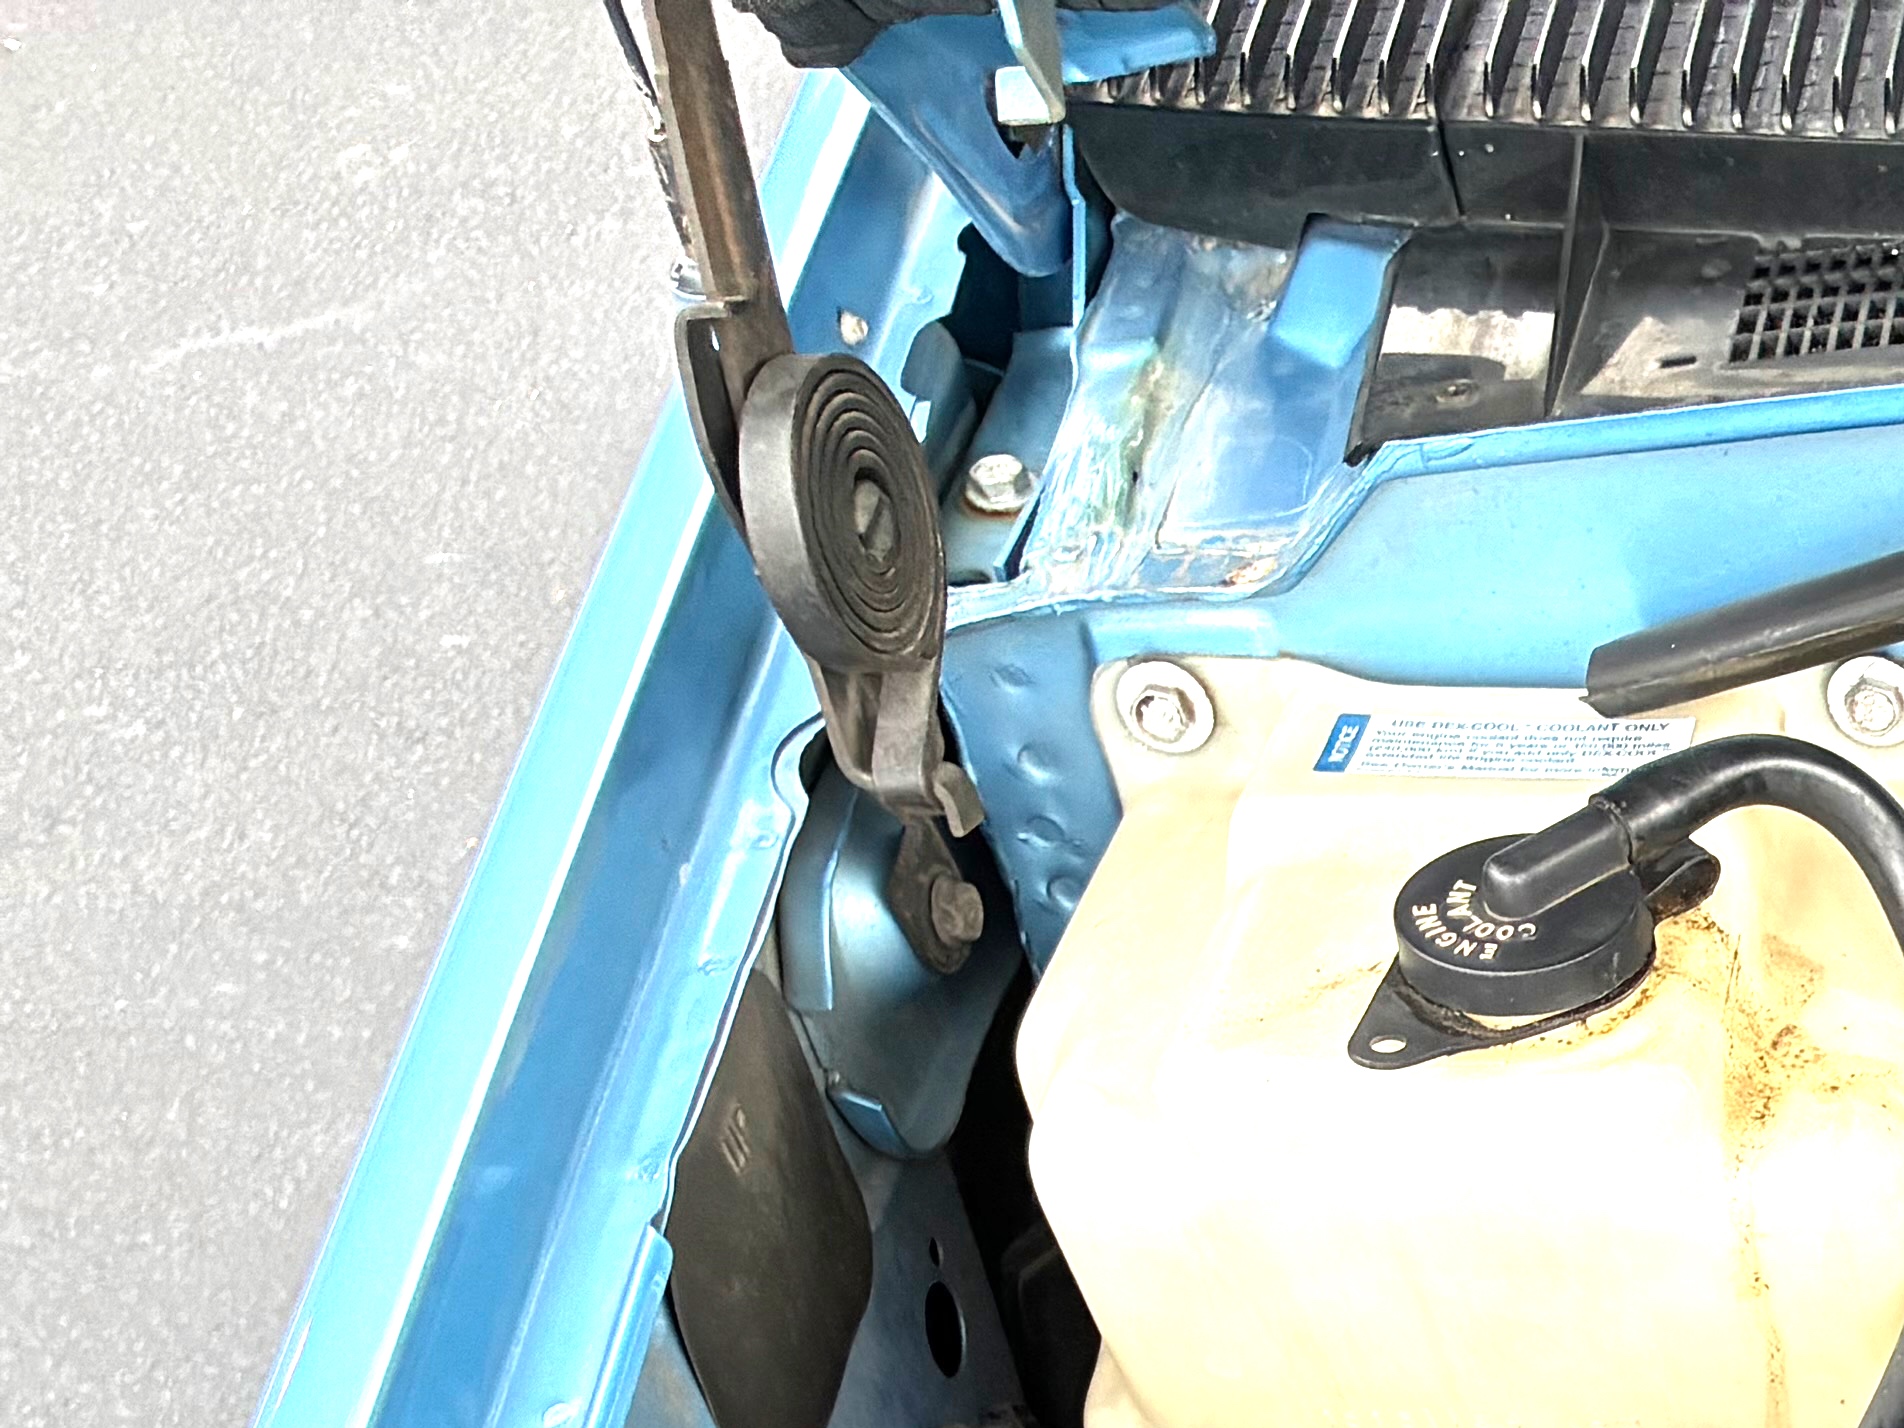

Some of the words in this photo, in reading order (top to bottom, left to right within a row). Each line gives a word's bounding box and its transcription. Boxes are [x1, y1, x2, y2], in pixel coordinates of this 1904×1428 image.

[1624, 722, 1670, 732] ONLY
[1411, 903, 1499, 960] ENGINE
[1446, 879, 1536, 941] COOLANT
